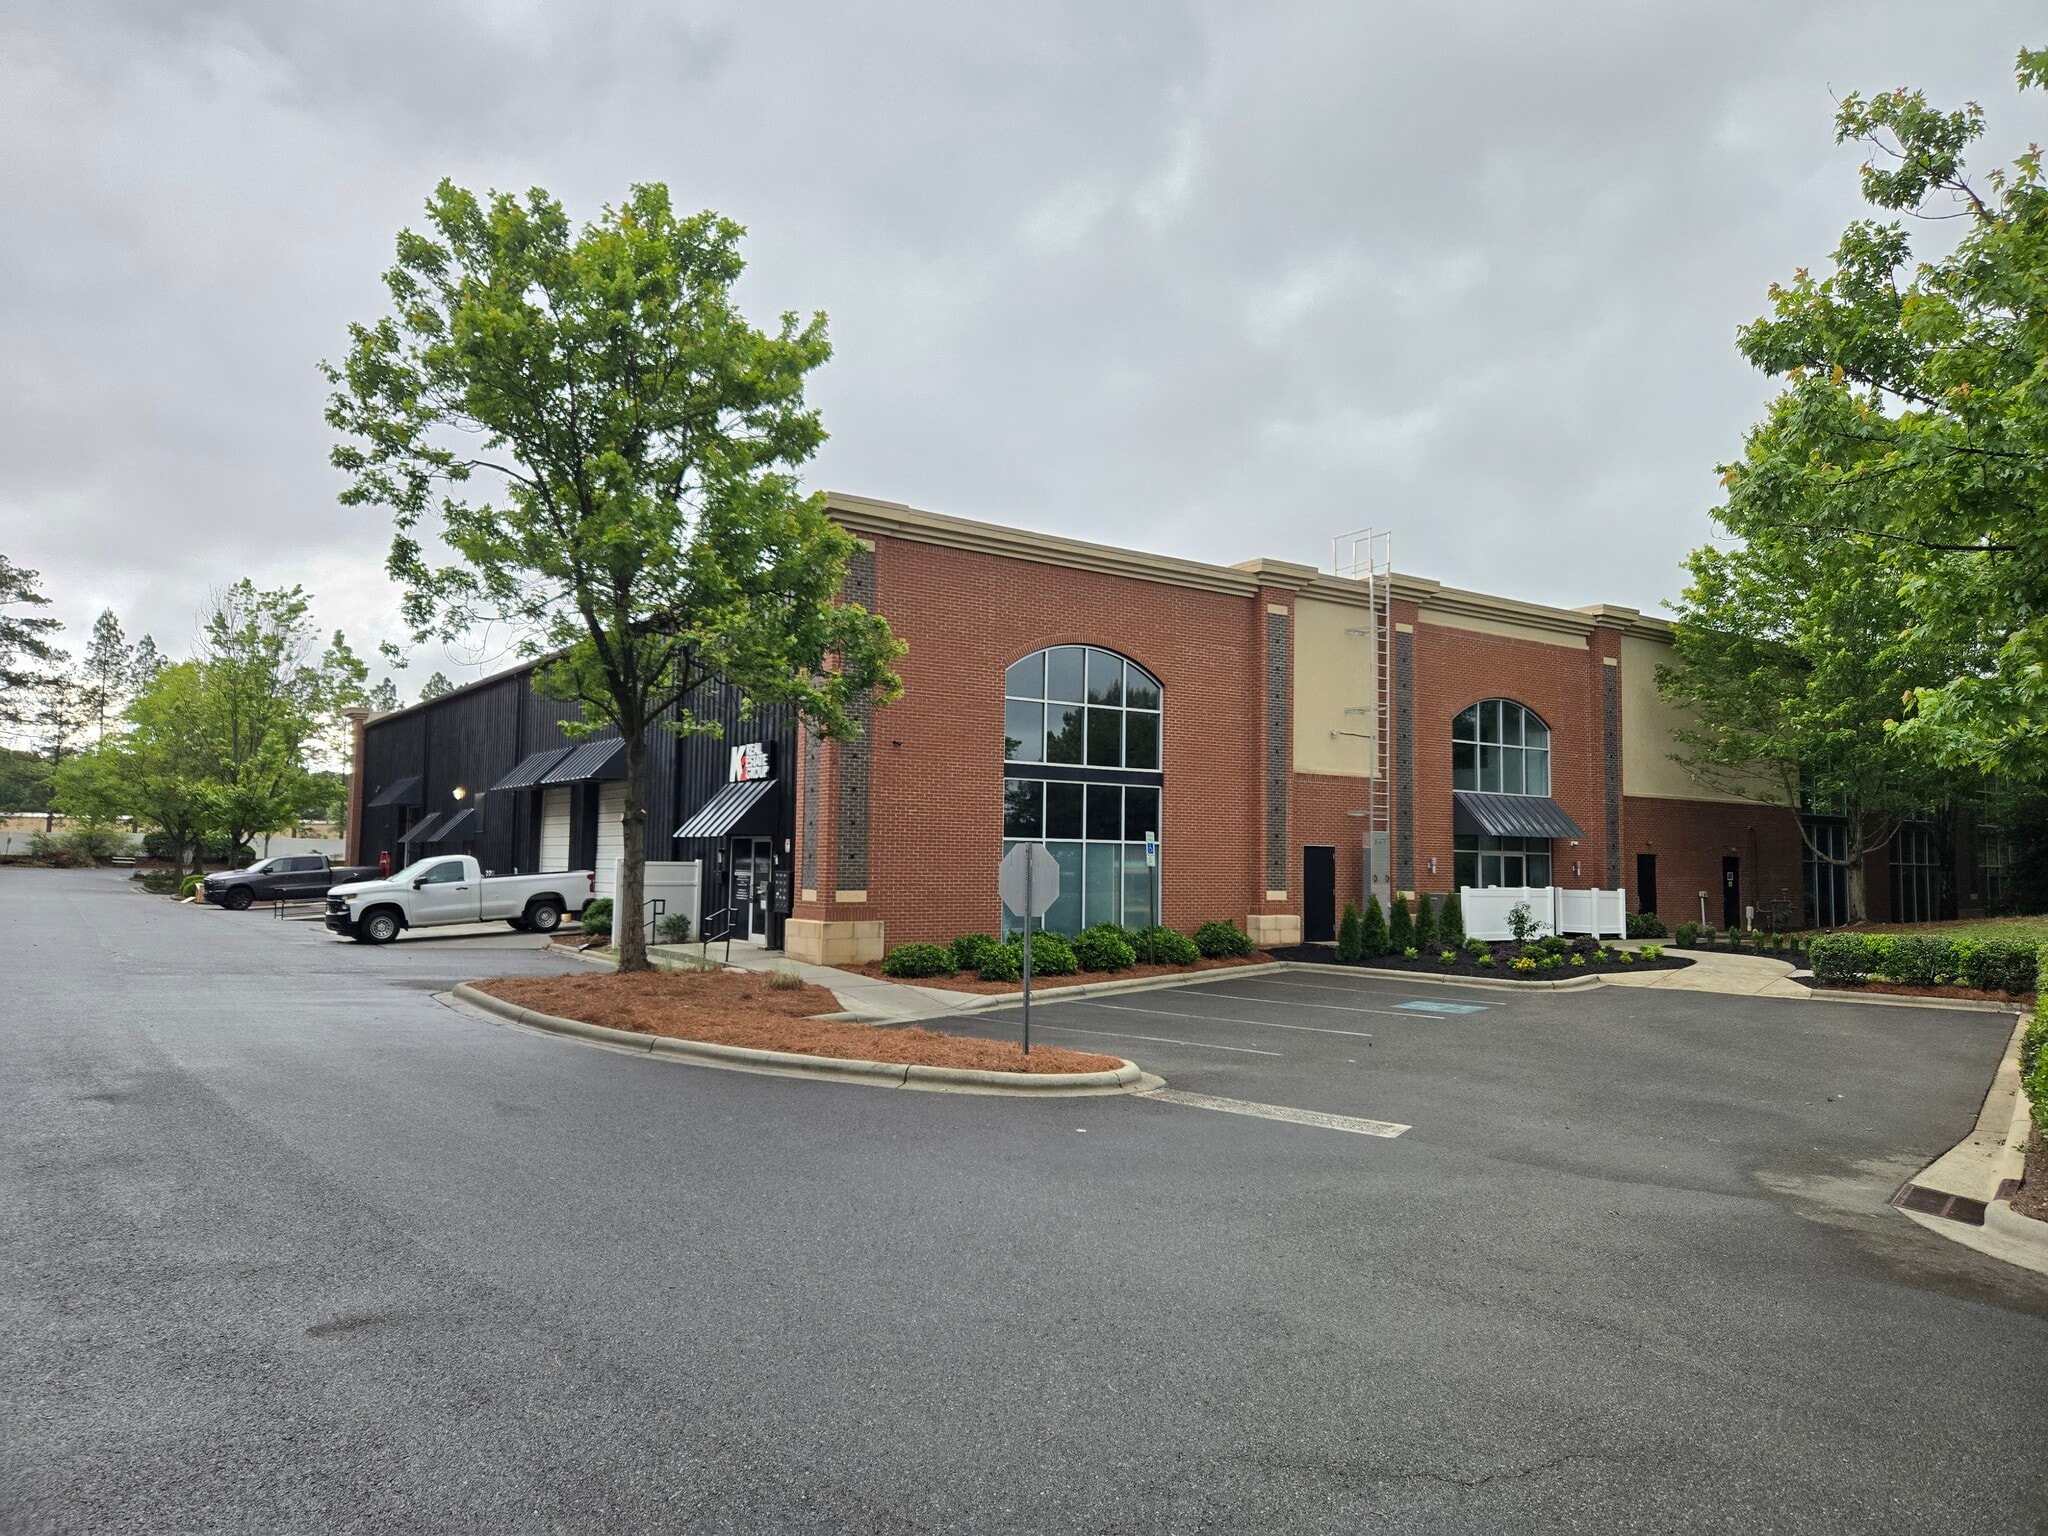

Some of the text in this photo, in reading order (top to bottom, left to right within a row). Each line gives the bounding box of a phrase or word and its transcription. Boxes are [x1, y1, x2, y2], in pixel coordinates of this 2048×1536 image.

[745, 742, 763, 755] REAL
[746, 753, 768, 766] ESTATE
[747, 765, 769, 778] GROUP
